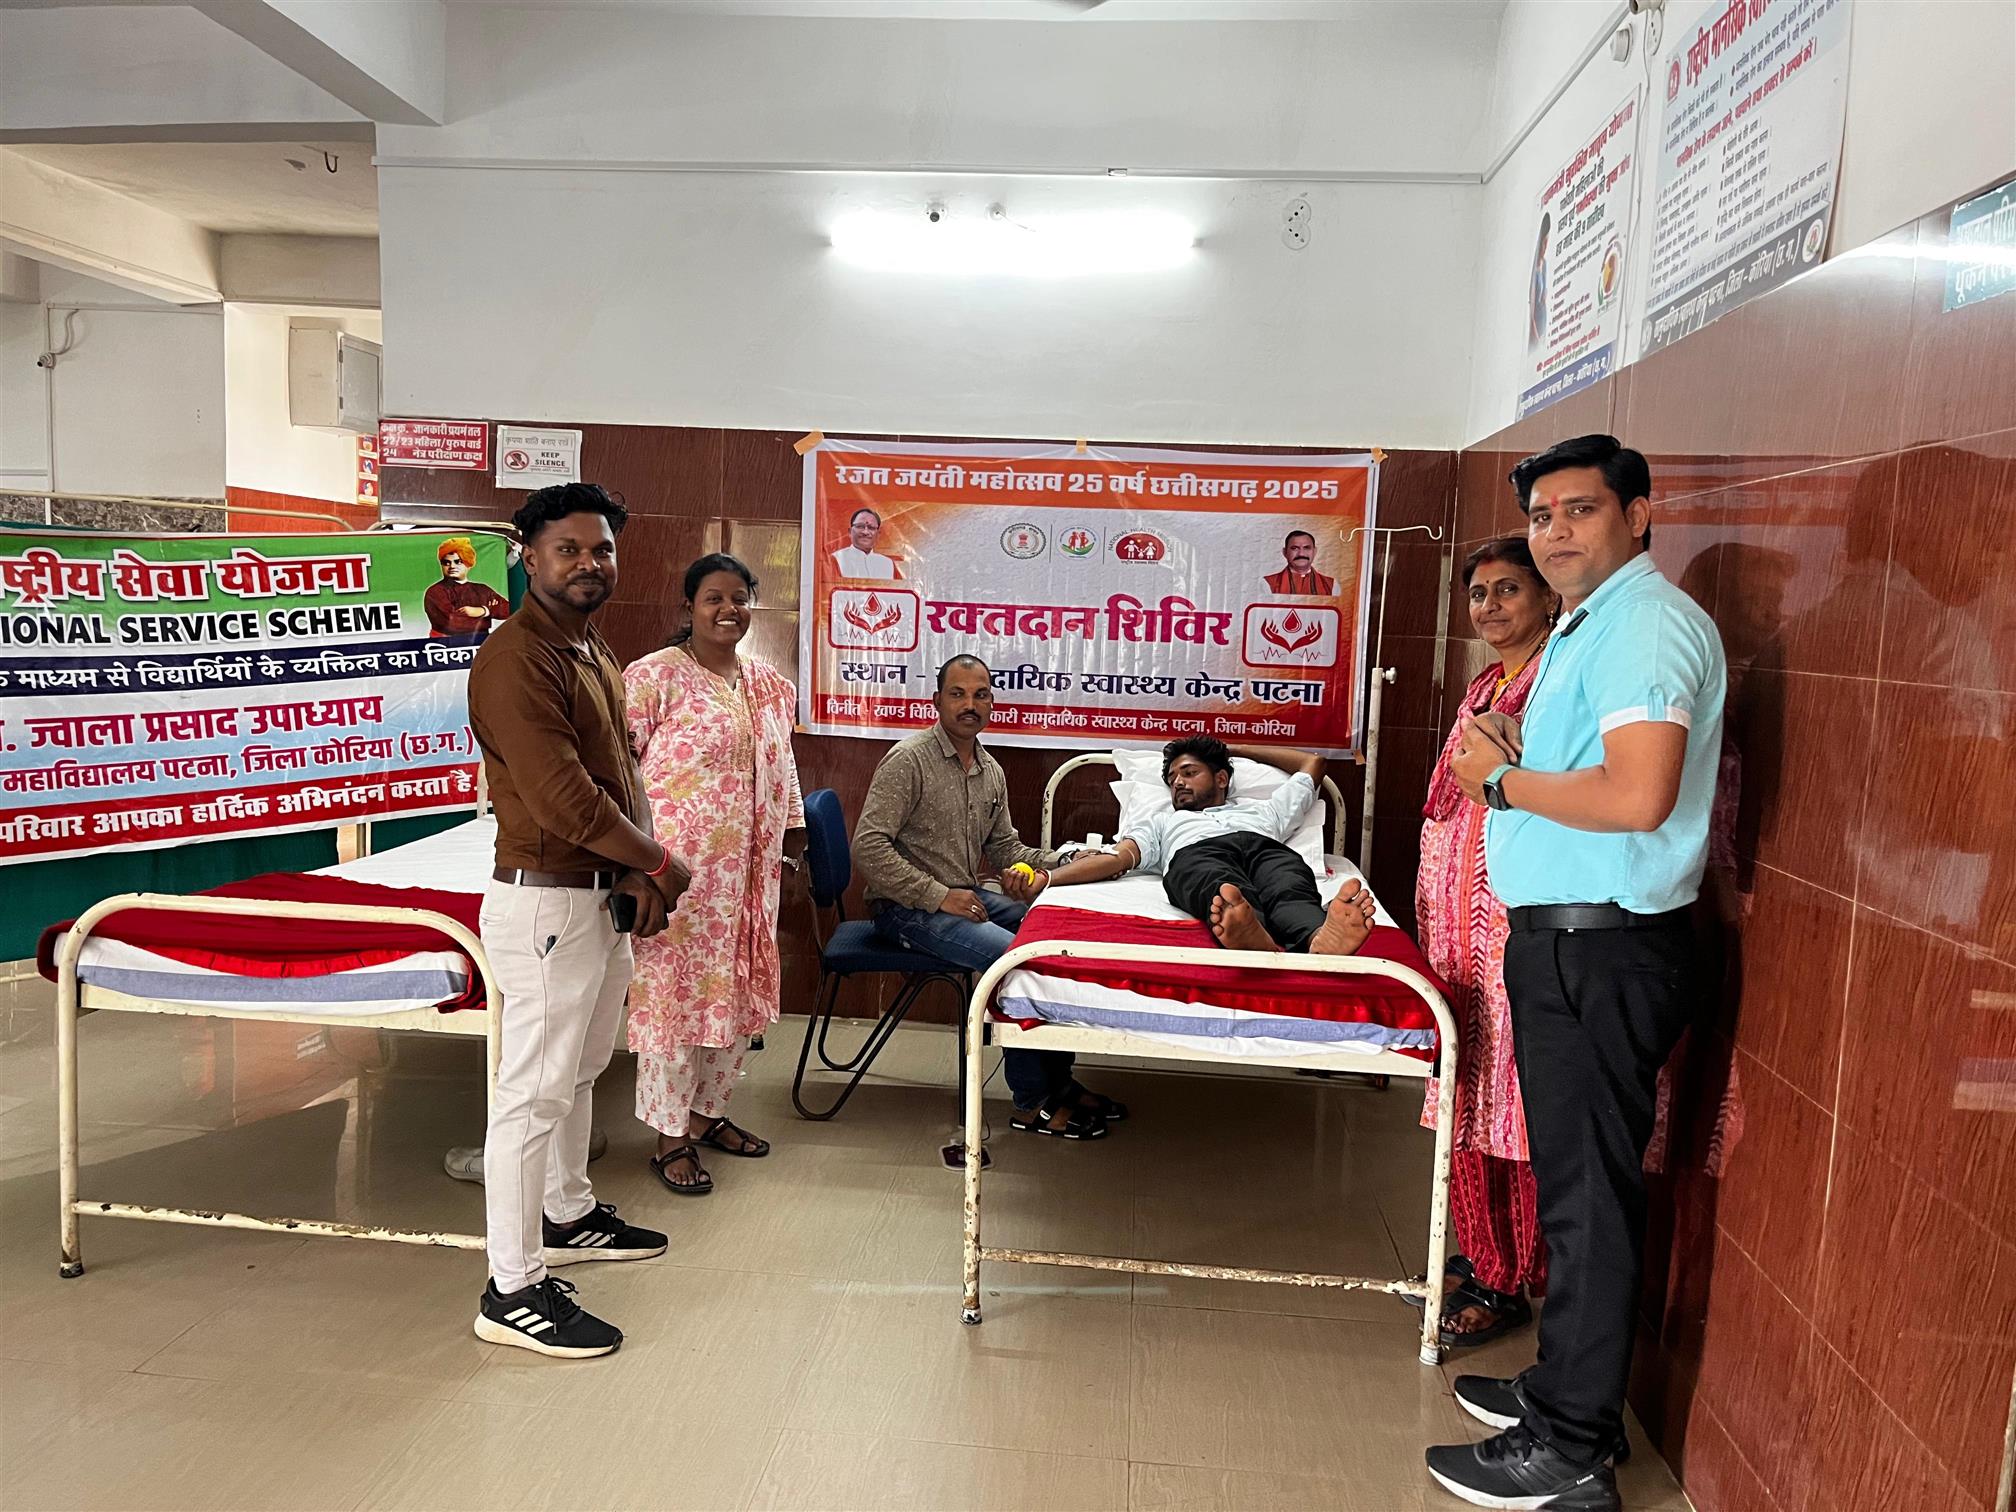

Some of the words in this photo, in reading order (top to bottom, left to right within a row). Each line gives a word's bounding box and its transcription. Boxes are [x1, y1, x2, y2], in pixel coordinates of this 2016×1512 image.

[1725, 268, 1744, 296] जिला
[1748, 249, 1774, 282] कोरिया
[383, 436, 413, 446] 22/23
[467, 438, 481, 449] वार्ड
[413, 423, 447, 435] जानकारी
[468, 427, 481, 436] तल
[383, 448, 396, 456] 24
[413, 447, 425, 458] नेत्र
[428, 449, 462, 460] परीक्षण
[464, 452, 482, 460] कक्ष
[835, 465, 891, 486] रजत
[894, 463, 966, 489] जयंती
[969, 467, 1064, 492] महोत्सव
[1068, 474, 1102, 493] 25
[1109, 471, 1147, 494] वर्ष
[1264, 480, 1339, 499] 2025
[0, 551, 102, 604] ष्ट्रीय
[113, 551, 208, 597] सेवा
[217, 550, 369, 592] योजना
[0, 615, 111, 643] IONAL
[121, 612, 258, 643] SERVICE
[269, 605, 400, 636] SCHEME
[925, 601, 1099, 641] रक्तदान
[1104, 593, 1232, 646] शिविर
[14, 669, 99, 689] माध्यम
[103, 661, 130, 687] से
[137, 655, 253, 687] विद्यार्थियों
[257, 655, 285, 677] के
[289, 650, 380, 676] व्यक्तित्व
[385, 650, 419, 668] का
[422, 643, 480, 666] विका
[841, 662, 908, 684] स्थान
[1081, 673, 1176, 696] स्वास्थ्य
[1185, 672, 1243, 702] केन्द्र
[1251, 680, 1323, 703] पटना
[24, 713, 135, 748] ज्वाला
[143, 706, 240, 744] प्रसाद
[246, 696, 383, 732] उपाध्याय
[826, 699, 861, 716] विनीत
[874, 704, 906, 718] खण्ड
[909, 703, 939, 719] चिकि
[989, 706, 1018, 724] कारी
[1022, 709, 1087, 729] सामुदायिक
[1092, 715, 1137, 729] स्वास्थ्य
[1141, 714, 1168, 732] केन्द्र
[1173, 717, 1211, 735] पटना,
[0, 759, 156, 792] महाविद्यालय
[160, 752, 237, 784] पटना,
[242, 744, 308, 776] जिला
[312, 736, 394, 767] कोरिया
[400, 726, 474, 761] (छ.ग.)
[0, 814, 85, 843] परिवार
[92, 806, 184, 834] आपका
[192, 795, 270, 823] हार्दिक
[277, 784, 384, 811] अभिनंदन
[390, 775, 449, 799] करता
